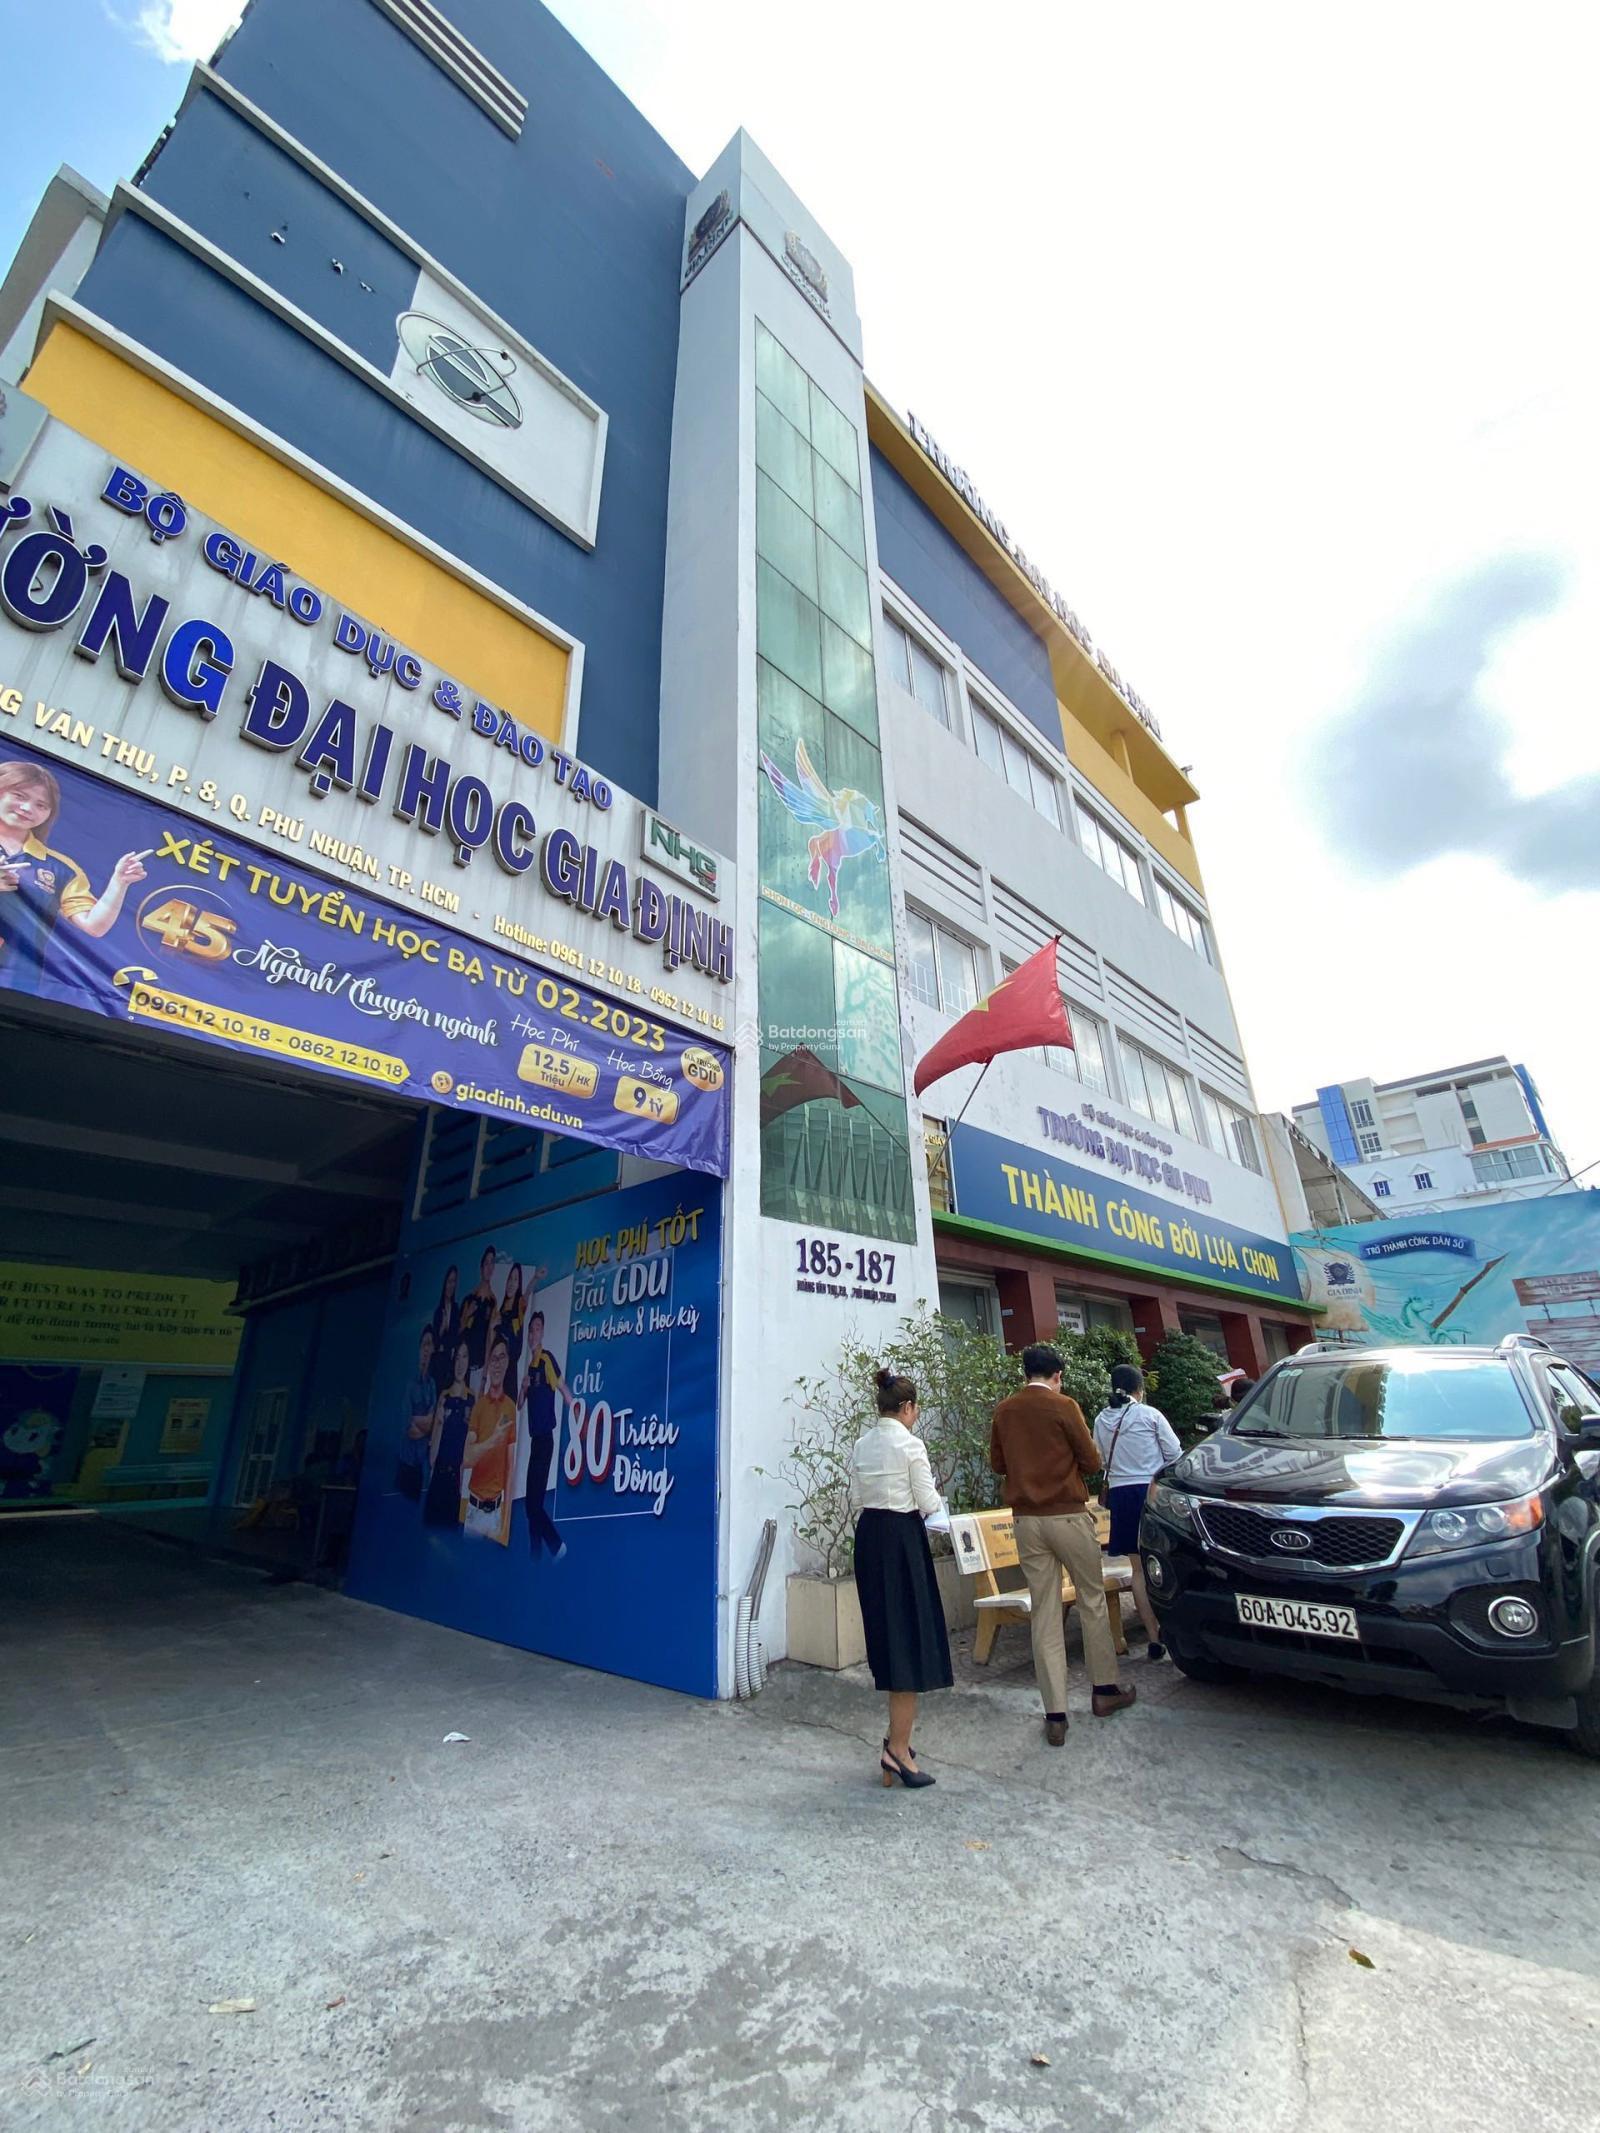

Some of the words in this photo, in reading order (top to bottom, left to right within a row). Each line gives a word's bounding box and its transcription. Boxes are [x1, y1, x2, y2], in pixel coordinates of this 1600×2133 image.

[101, 465, 188, 545] BỘ
[204, 532, 323, 625] GIÁO
[334, 613, 424, 689] DỤC
[434, 680, 463, 720] &
[472, 700, 545, 768] ĐÀO
[551, 749, 614, 811] TẠO
[240, 658, 395, 798] ĐẠI
[394, 742, 537, 870] HỌC
[541, 826, 631, 931] GIA
[633, 876, 736, 984] ĐỊNH
[34, 703, 95, 748] VĂN
[101, 732, 160, 783] THỤ,
[167, 764, 191, 795] P.
[198, 780, 221, 810] 8,
[229, 793, 251, 821] Q.
[258, 806, 305, 843] PHÚ
[309, 829, 382, 881] NHUẬN,
[388, 865, 416, 894] TP.
[420, 879, 460, 914] HCM
[493, 914, 547, 957] Hotline:
[550, 940, 584, 969] 0961
[588, 958, 604, 978] 12
[608, 967, 624, 986] 10
[626, 974, 641, 994] 18
[650, 986, 677, 1010] 0962
[142, 898, 237, 961] 45
[155, 830, 241, 882] XÉT
[247, 862, 366, 935] TUYỂN
[371, 917, 440, 963] HỌC
[448, 947, 485, 985] BẠ
[490, 964, 528, 996] TỪ
[535, 977, 667, 1052] 02.2023
[135, 991, 188, 1018] 0961
[194, 1008, 216, 1027] 12
[223, 1016, 244, 1034] 10
[249, 1024, 271, 1042] 18
[288, 1035, 335, 1060] 0862
[340, 1049, 358, 1066] 12
[362, 1055, 381, 1072] 10
[385, 1061, 403, 1078] 18
[432, 1009, 499, 1047] ngành
[510, 1013, 548, 1043] Học
[550, 1026, 581, 1053] Phí
[533, 1049, 570, 1076] 12.5
[540, 1071, 566, 1088] Triệu
[607, 1049, 636, 1074] Học
[688, 1063, 717, 1084] GDU
[456, 1081, 583, 1130] giadinh.edu.vn
[633, 1086, 648, 1109] 9
[576, 1233, 611, 1271] HỌC
[617, 1219, 648, 1260] PHÍ
[654, 1203, 704, 1249] TỐT
[1002, 1164, 1099, 1229] THÀNH
[1106, 1198, 1165, 1249] CÔNG
[1169, 1218, 1202, 1261] BỞI
[1205, 1233, 1240, 1273] LỰA
[1242, 1247, 1281, 1285] CHỌN
[1382, 1239, 1407, 1254] THÀNH
[574, 1276, 606, 1312] Tại
[612, 1258, 670, 1305] GDU
[650, 1305, 677, 1331] Học
[573, 1360, 604, 1396] chỉ
[563, 1398, 616, 1486] 80
[613, 1408, 680, 1451] Triệu
[612, 1453, 676, 1517] Đồng
[1277, 1533, 1303, 1548] KIA
[1240, 1597, 1357, 1638] 60A-045.92
